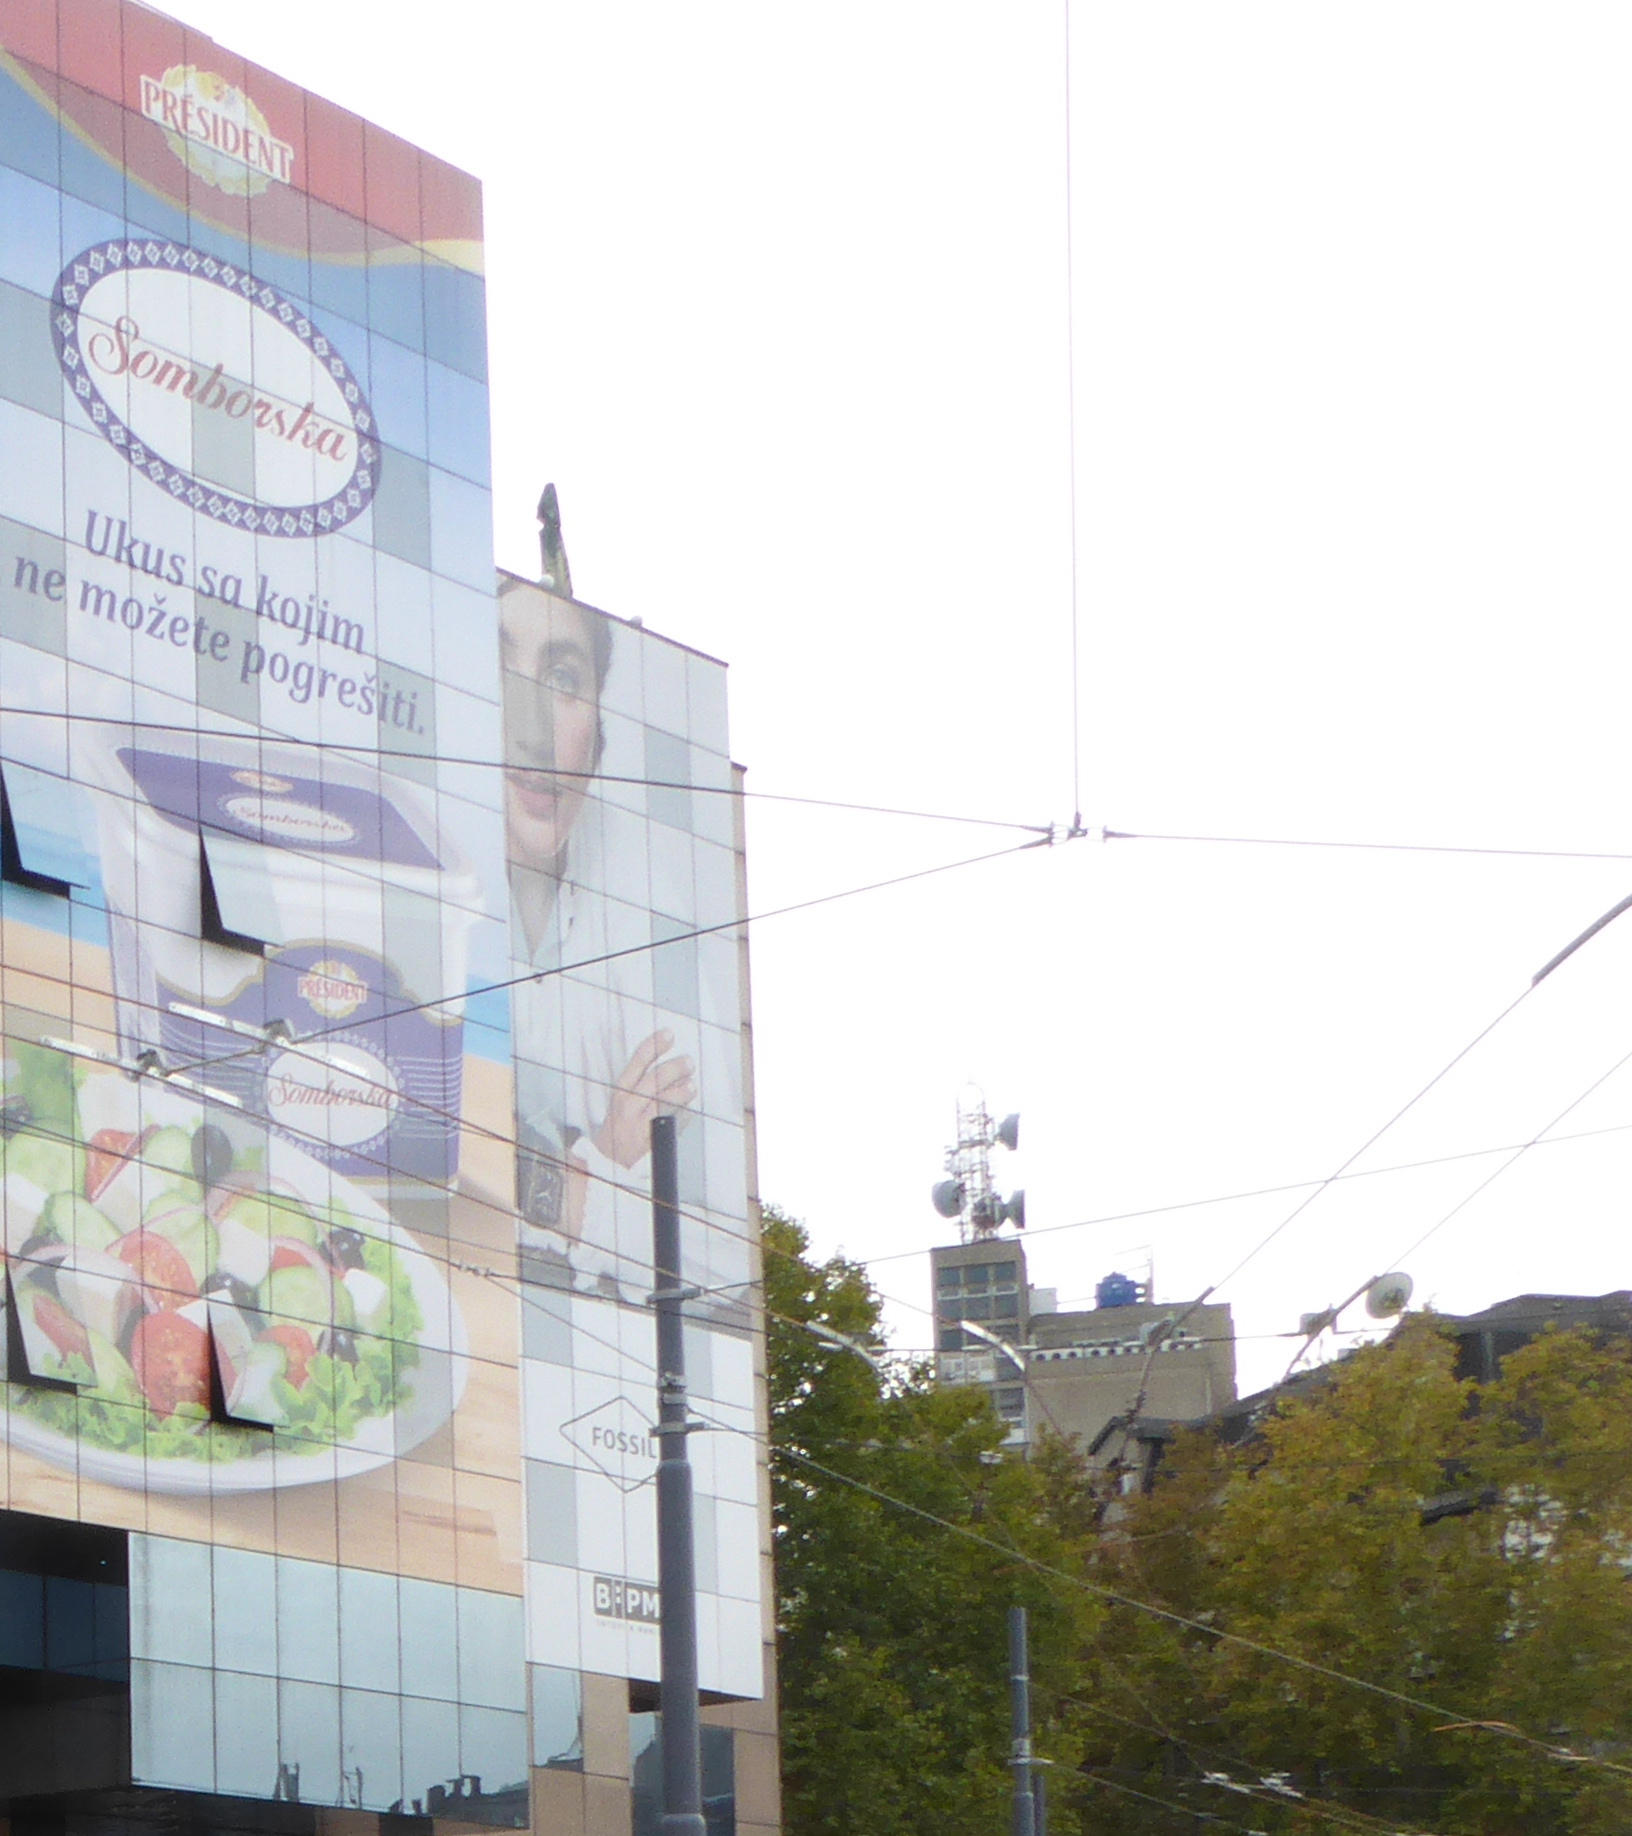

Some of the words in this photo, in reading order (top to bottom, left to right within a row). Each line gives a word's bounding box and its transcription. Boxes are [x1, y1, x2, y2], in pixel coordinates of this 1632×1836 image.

[142, 78, 293, 182] PRÉSIDENT
[88, 316, 348, 462] Somborska
[14, 555, 66, 602] ne
[79, 578, 231, 662] možete
[240, 638, 425, 735] pogrešiti.
[84, 509, 187, 587] Ukus
[197, 564, 243, 606] sa
[256, 573, 366, 655] kojim
[592, 1426, 658, 1460] FOSSIL
